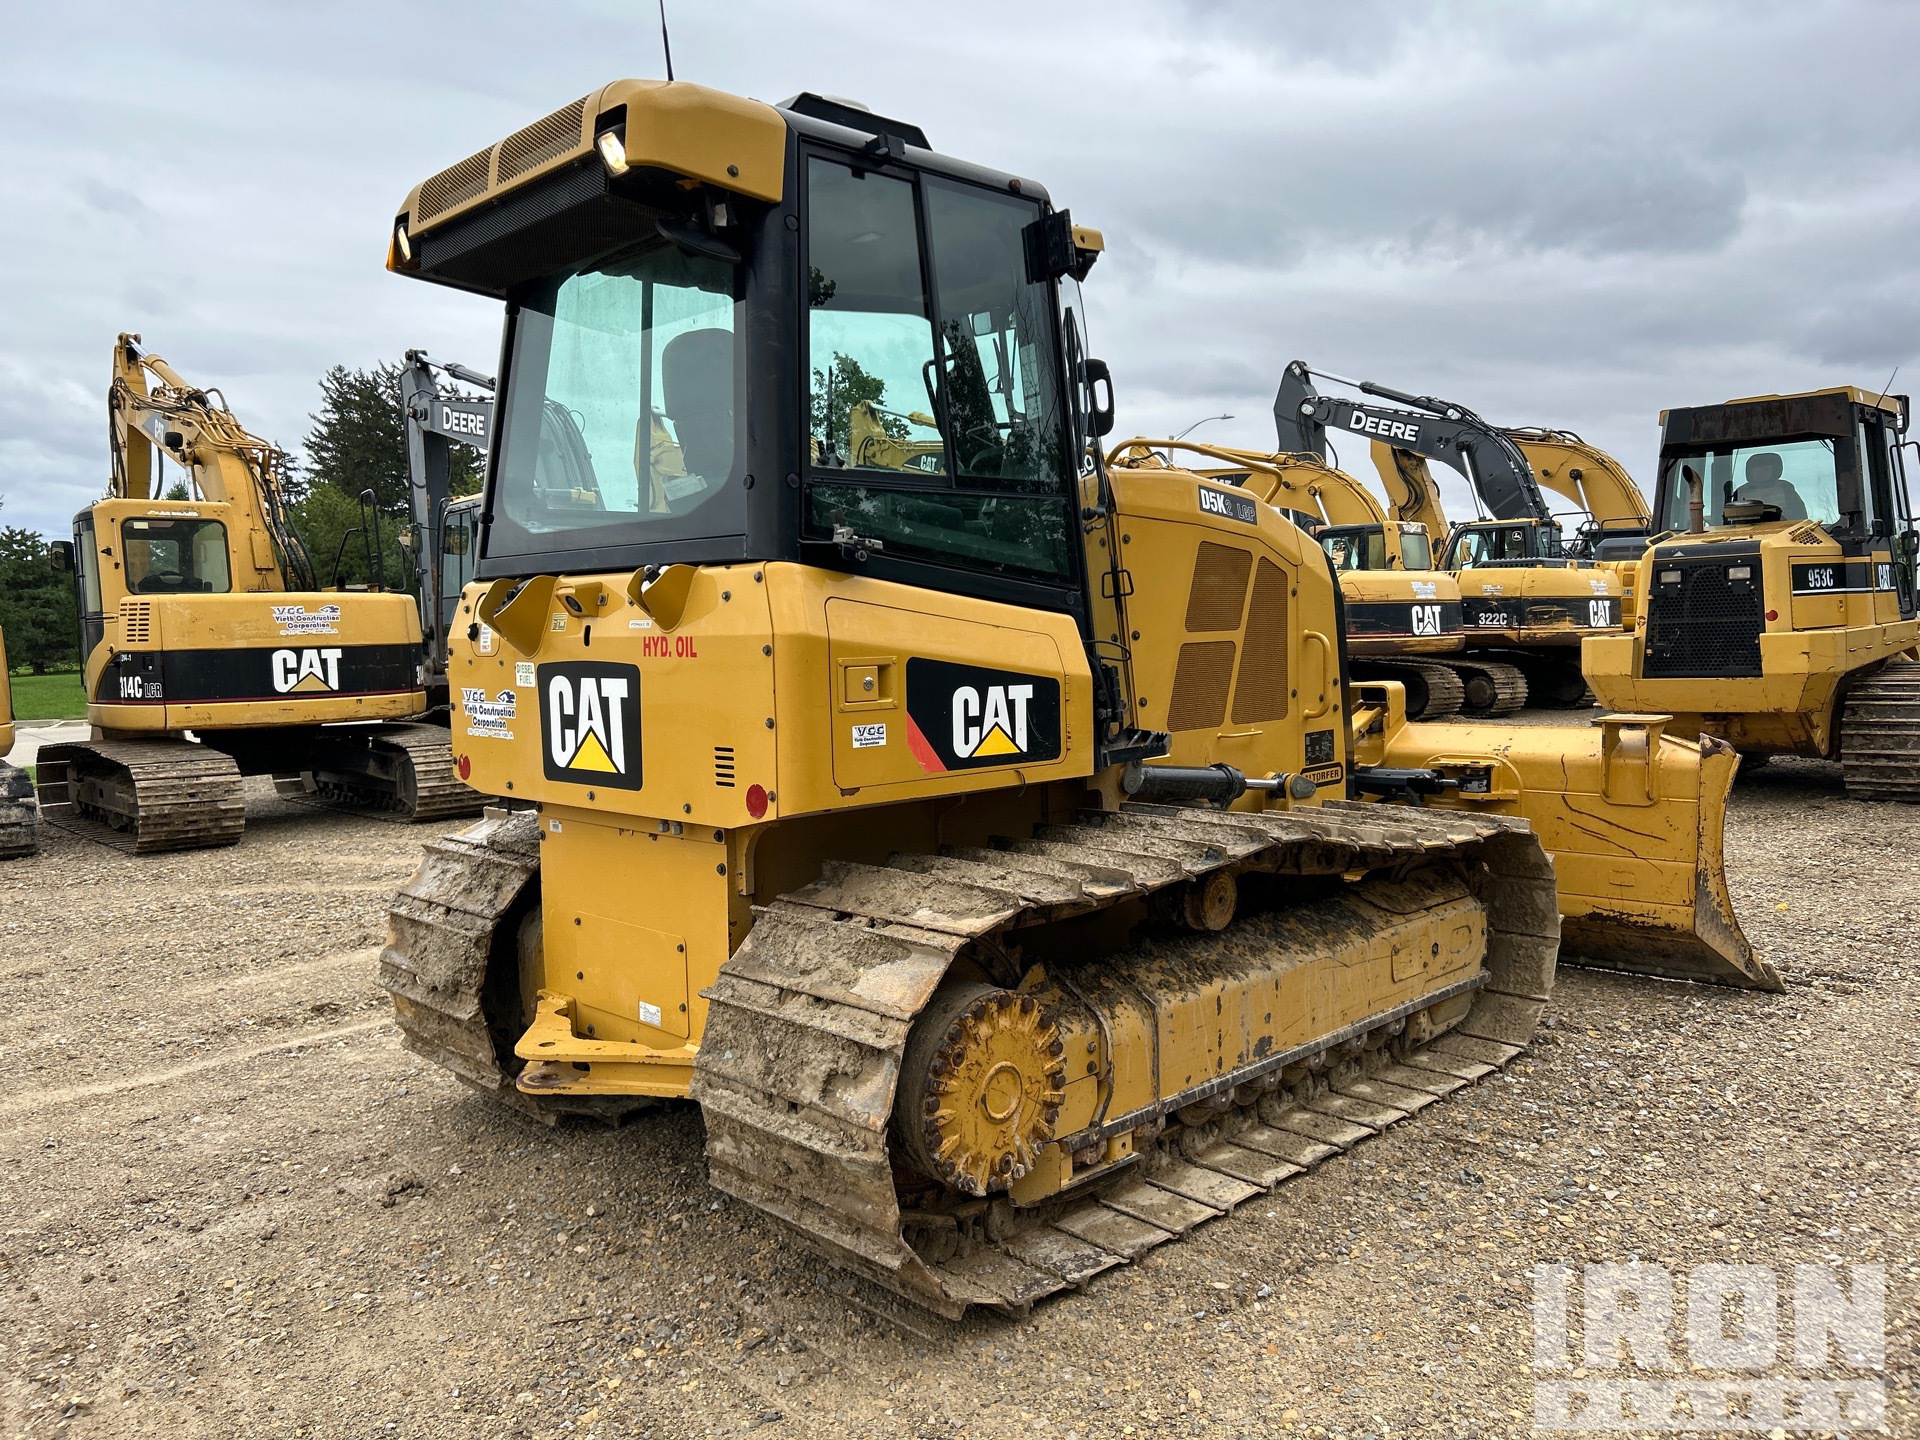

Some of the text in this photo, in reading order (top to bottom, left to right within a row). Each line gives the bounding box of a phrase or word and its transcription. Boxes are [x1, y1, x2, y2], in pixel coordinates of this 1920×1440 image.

[443, 406, 485, 436] DEERE
[1349, 410, 1419, 442] DEERE
[920, 455, 937, 472] CAT
[1808, 566, 1834, 588] 953C
[1878, 564, 1891, 590] CAT
[1411, 605, 1442, 636] CAT
[1478, 612, 1508, 626] 322C
[1589, 599, 1611, 628] CAT
[287, 622, 330, 630] Corporation
[643, 635, 698, 658] HYD. OIL
[272, 648, 342, 693] CAT
[516, 664, 534, 674] DIESEL
[519, 674, 532, 685] FUEL
[144, 682, 163, 698] LCR
[478, 704, 516, 718] Construction
[952, 684, 1033, 759] CAT
[472, 716, 507, 729] Corporation
[549, 675, 628, 775] CAT
